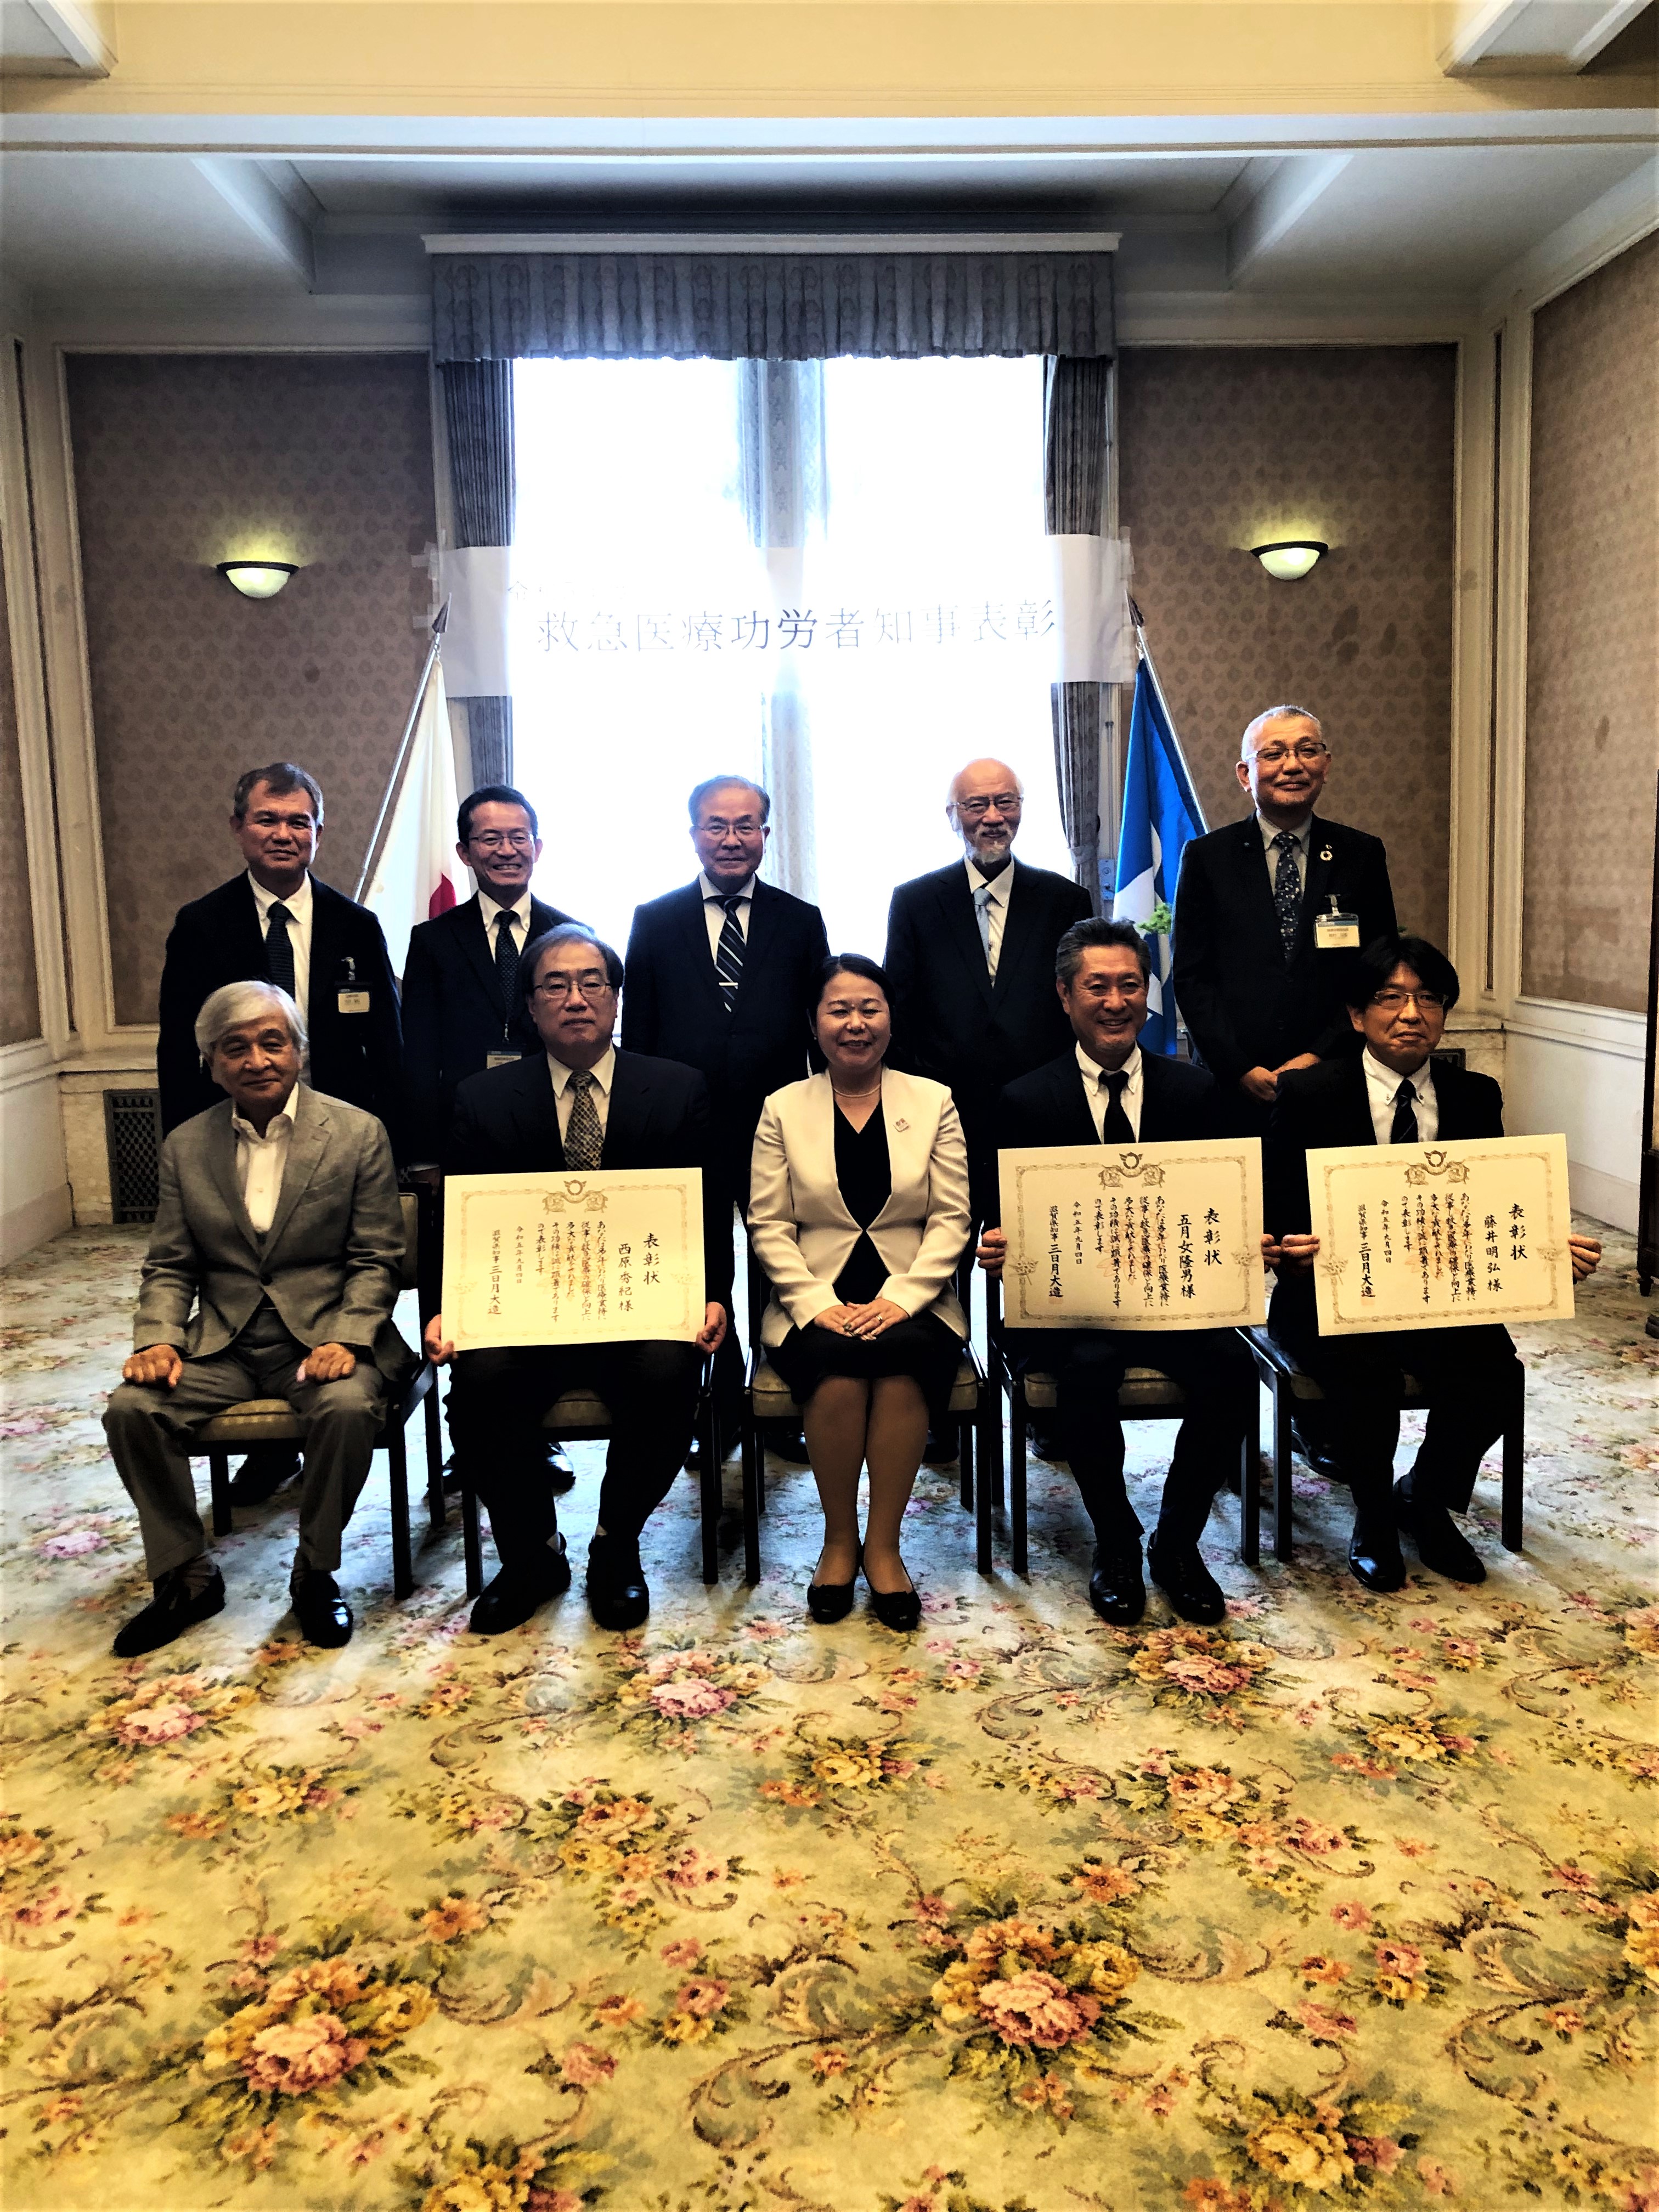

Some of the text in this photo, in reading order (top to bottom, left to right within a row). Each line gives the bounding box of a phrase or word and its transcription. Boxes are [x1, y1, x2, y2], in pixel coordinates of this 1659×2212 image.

[537, 598, 1057, 653] 救急医療功労者知事表彰
[515, 1226, 524, 1284] 令和五年九月四日
[643, 1233, 660, 1285] 表彰状
[1073, 1201, 1083, 1264] 令和五年九月四日
[1177, 1214, 1196, 1299] 五月女隆男様
[1204, 1207, 1222, 1266] 表彰状
[1381, 1199, 1392, 1263] 令和五年九月四日
[1484, 1214, 1503, 1292] 藤井明弘様
[1508, 1203, 1528, 1261] 表彰状
[487, 1265, 503, 1315] 三日月大造
[618, 1243, 634, 1312] 西原秀紀様
[1048, 1243, 1064, 1297] 三日月大造
[1358, 1242, 1376, 1297] 三日月大造
